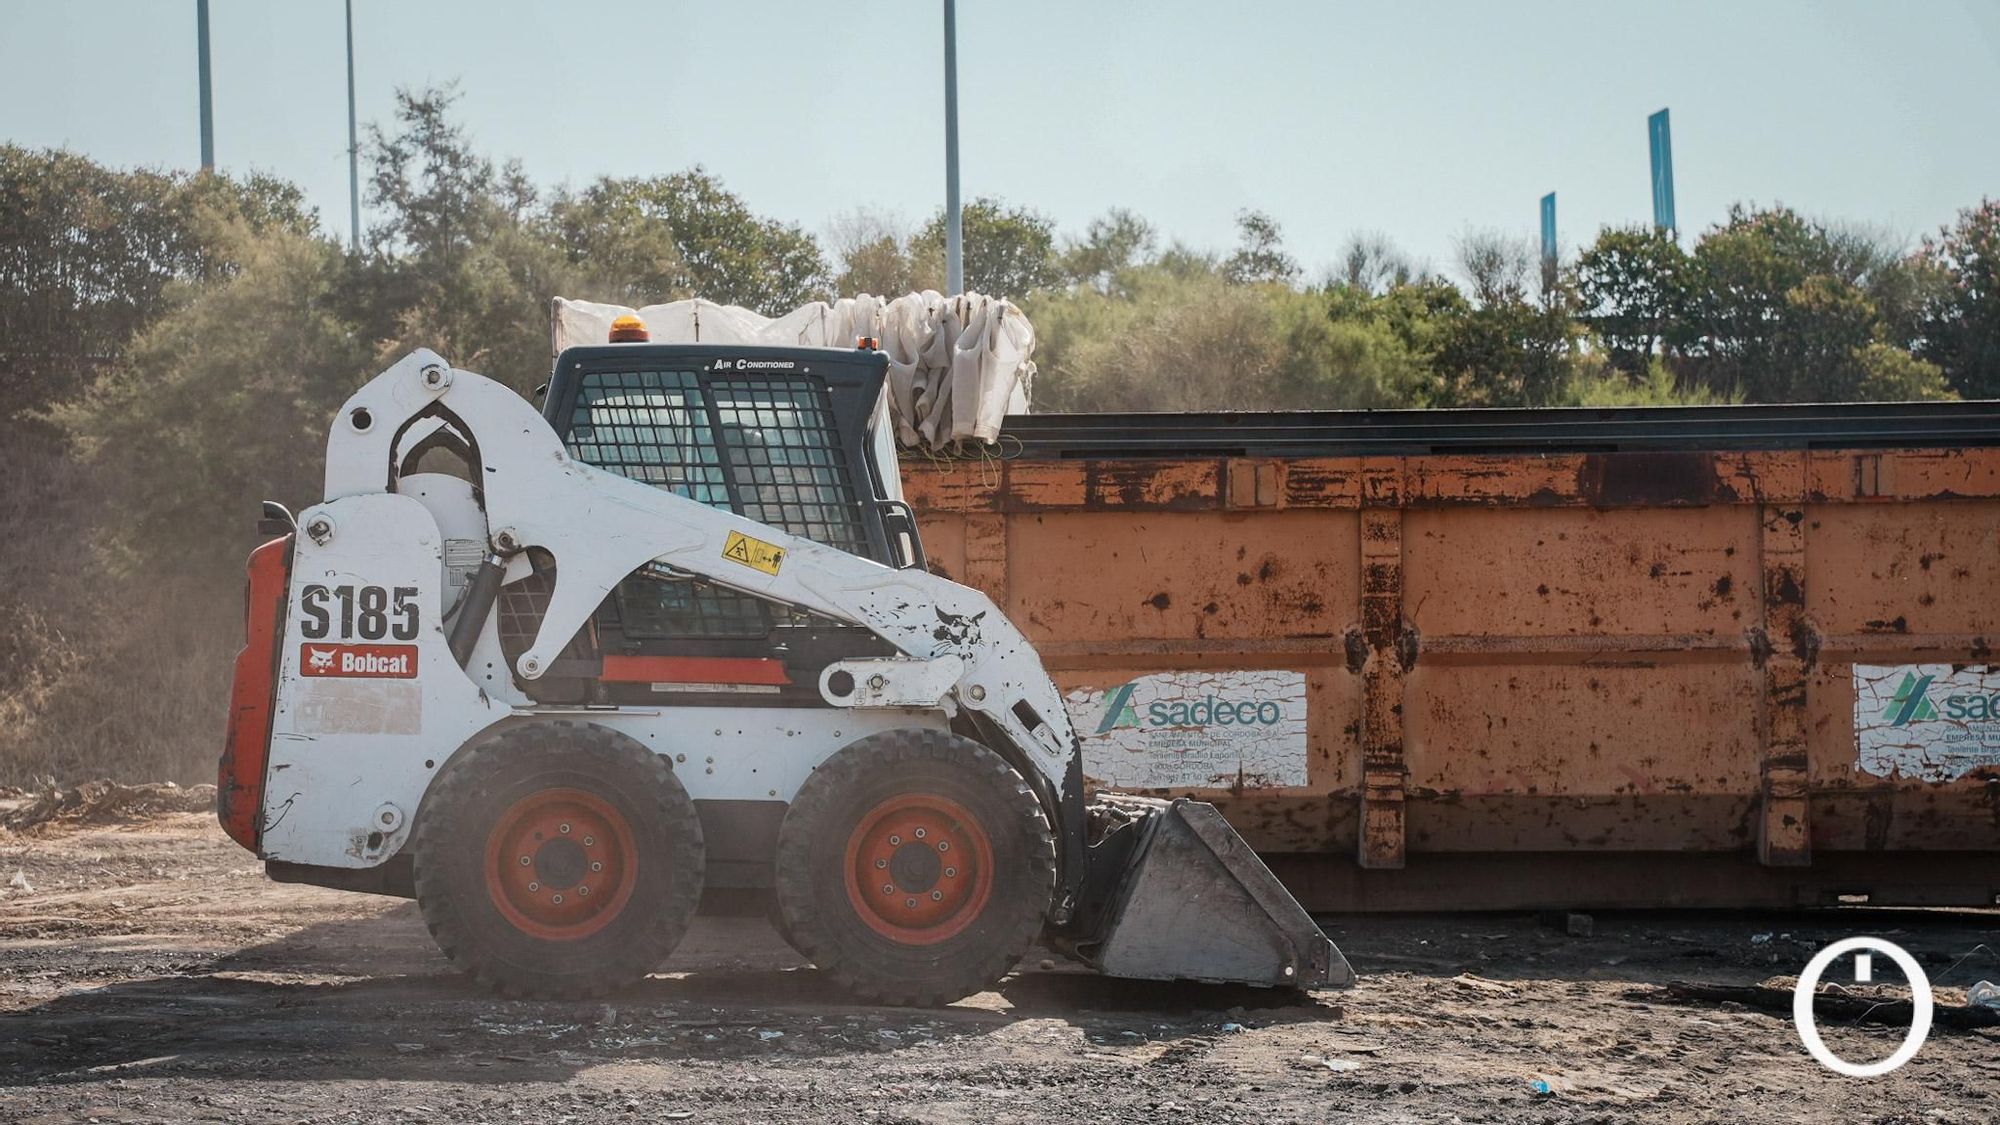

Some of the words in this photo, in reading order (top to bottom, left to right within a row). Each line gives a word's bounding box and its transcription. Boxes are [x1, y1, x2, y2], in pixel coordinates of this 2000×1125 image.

[301, 584, 420, 641] S185
[341, 652, 408, 673] Bobcat
[1149, 694, 1280, 726] sadeco
